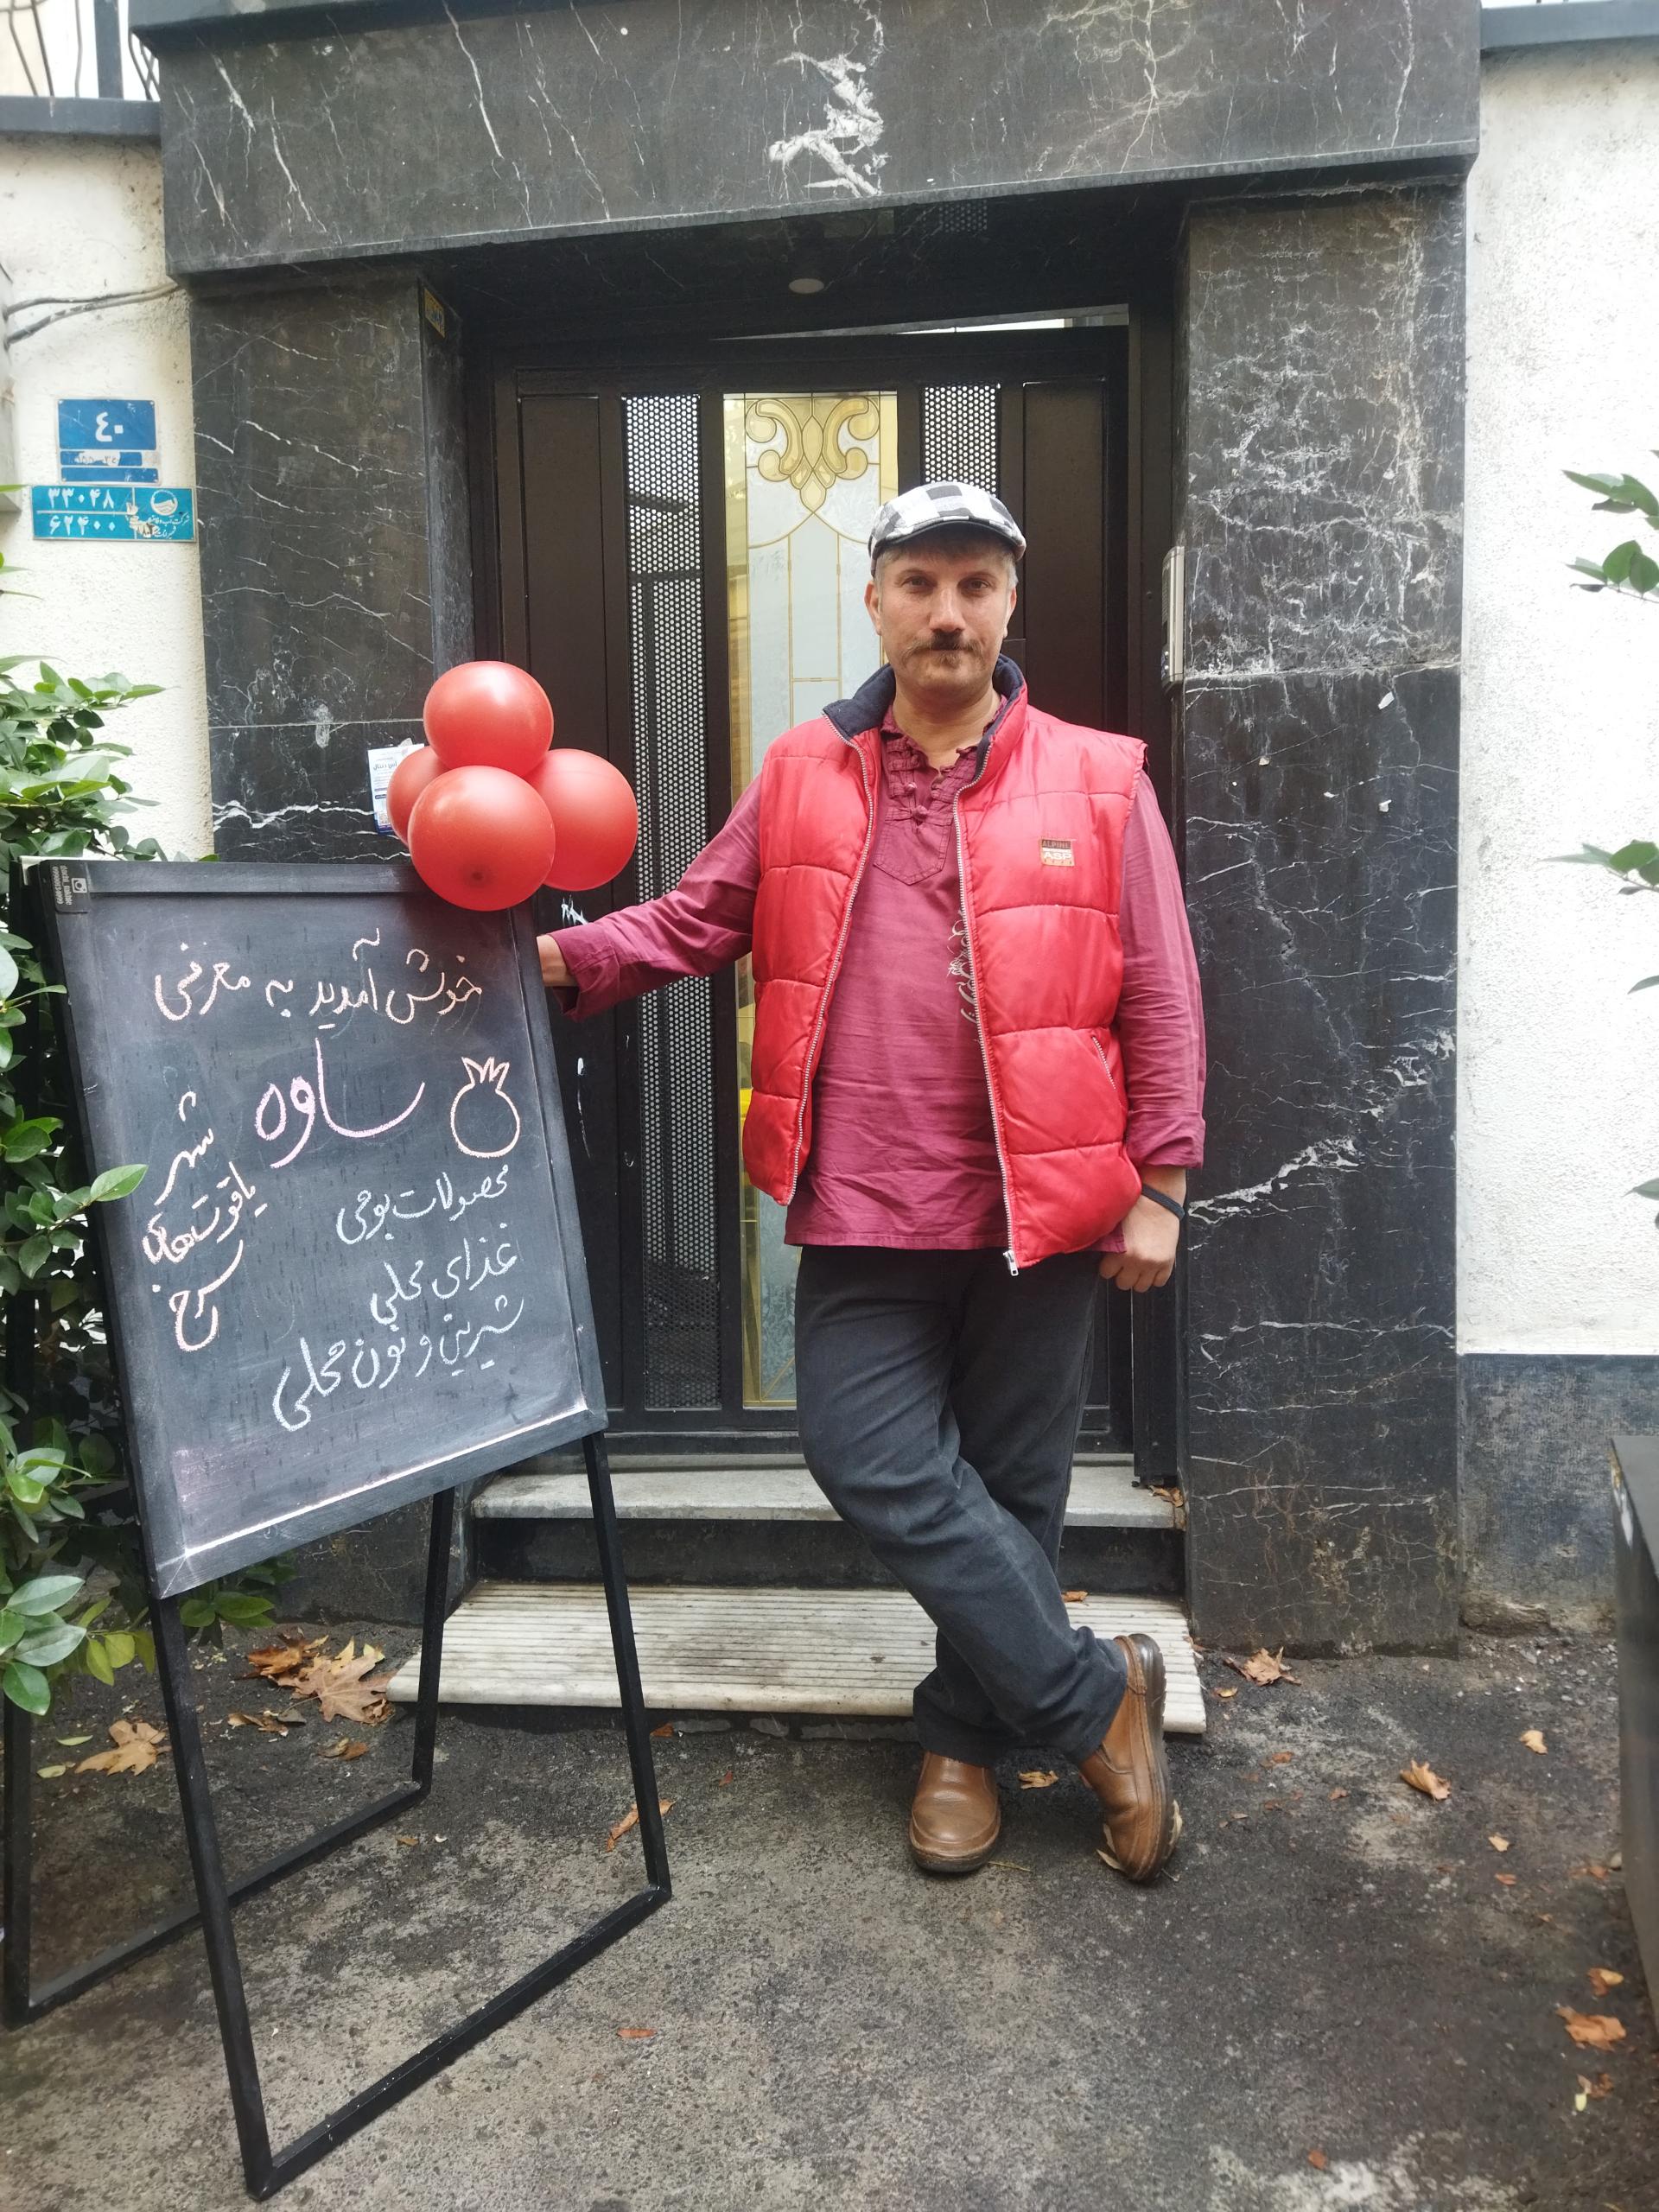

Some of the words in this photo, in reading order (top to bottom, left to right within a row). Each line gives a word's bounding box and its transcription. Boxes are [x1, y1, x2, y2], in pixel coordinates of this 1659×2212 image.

[155, 942, 251, 1021] معرفی
[265, 979, 294, 1018] به
[309, 928, 380, 1030] آمدید
[385, 948, 482, 1024] خوش
[254, 1037, 426, 1168] ساوه
[154, 1090, 214, 1206] شهر
[335, 1189, 395, 1245] بومی
[391, 1164, 509, 1221] محصولات
[151, 1239, 244, 1352] سرخ
[370, 1259, 423, 1325] محلی
[432, 1222, 518, 1300] غذای
[271, 1337, 346, 1433] محلی
[351, 1324, 407, 1389] نون
[414, 1334, 433, 1378] و
